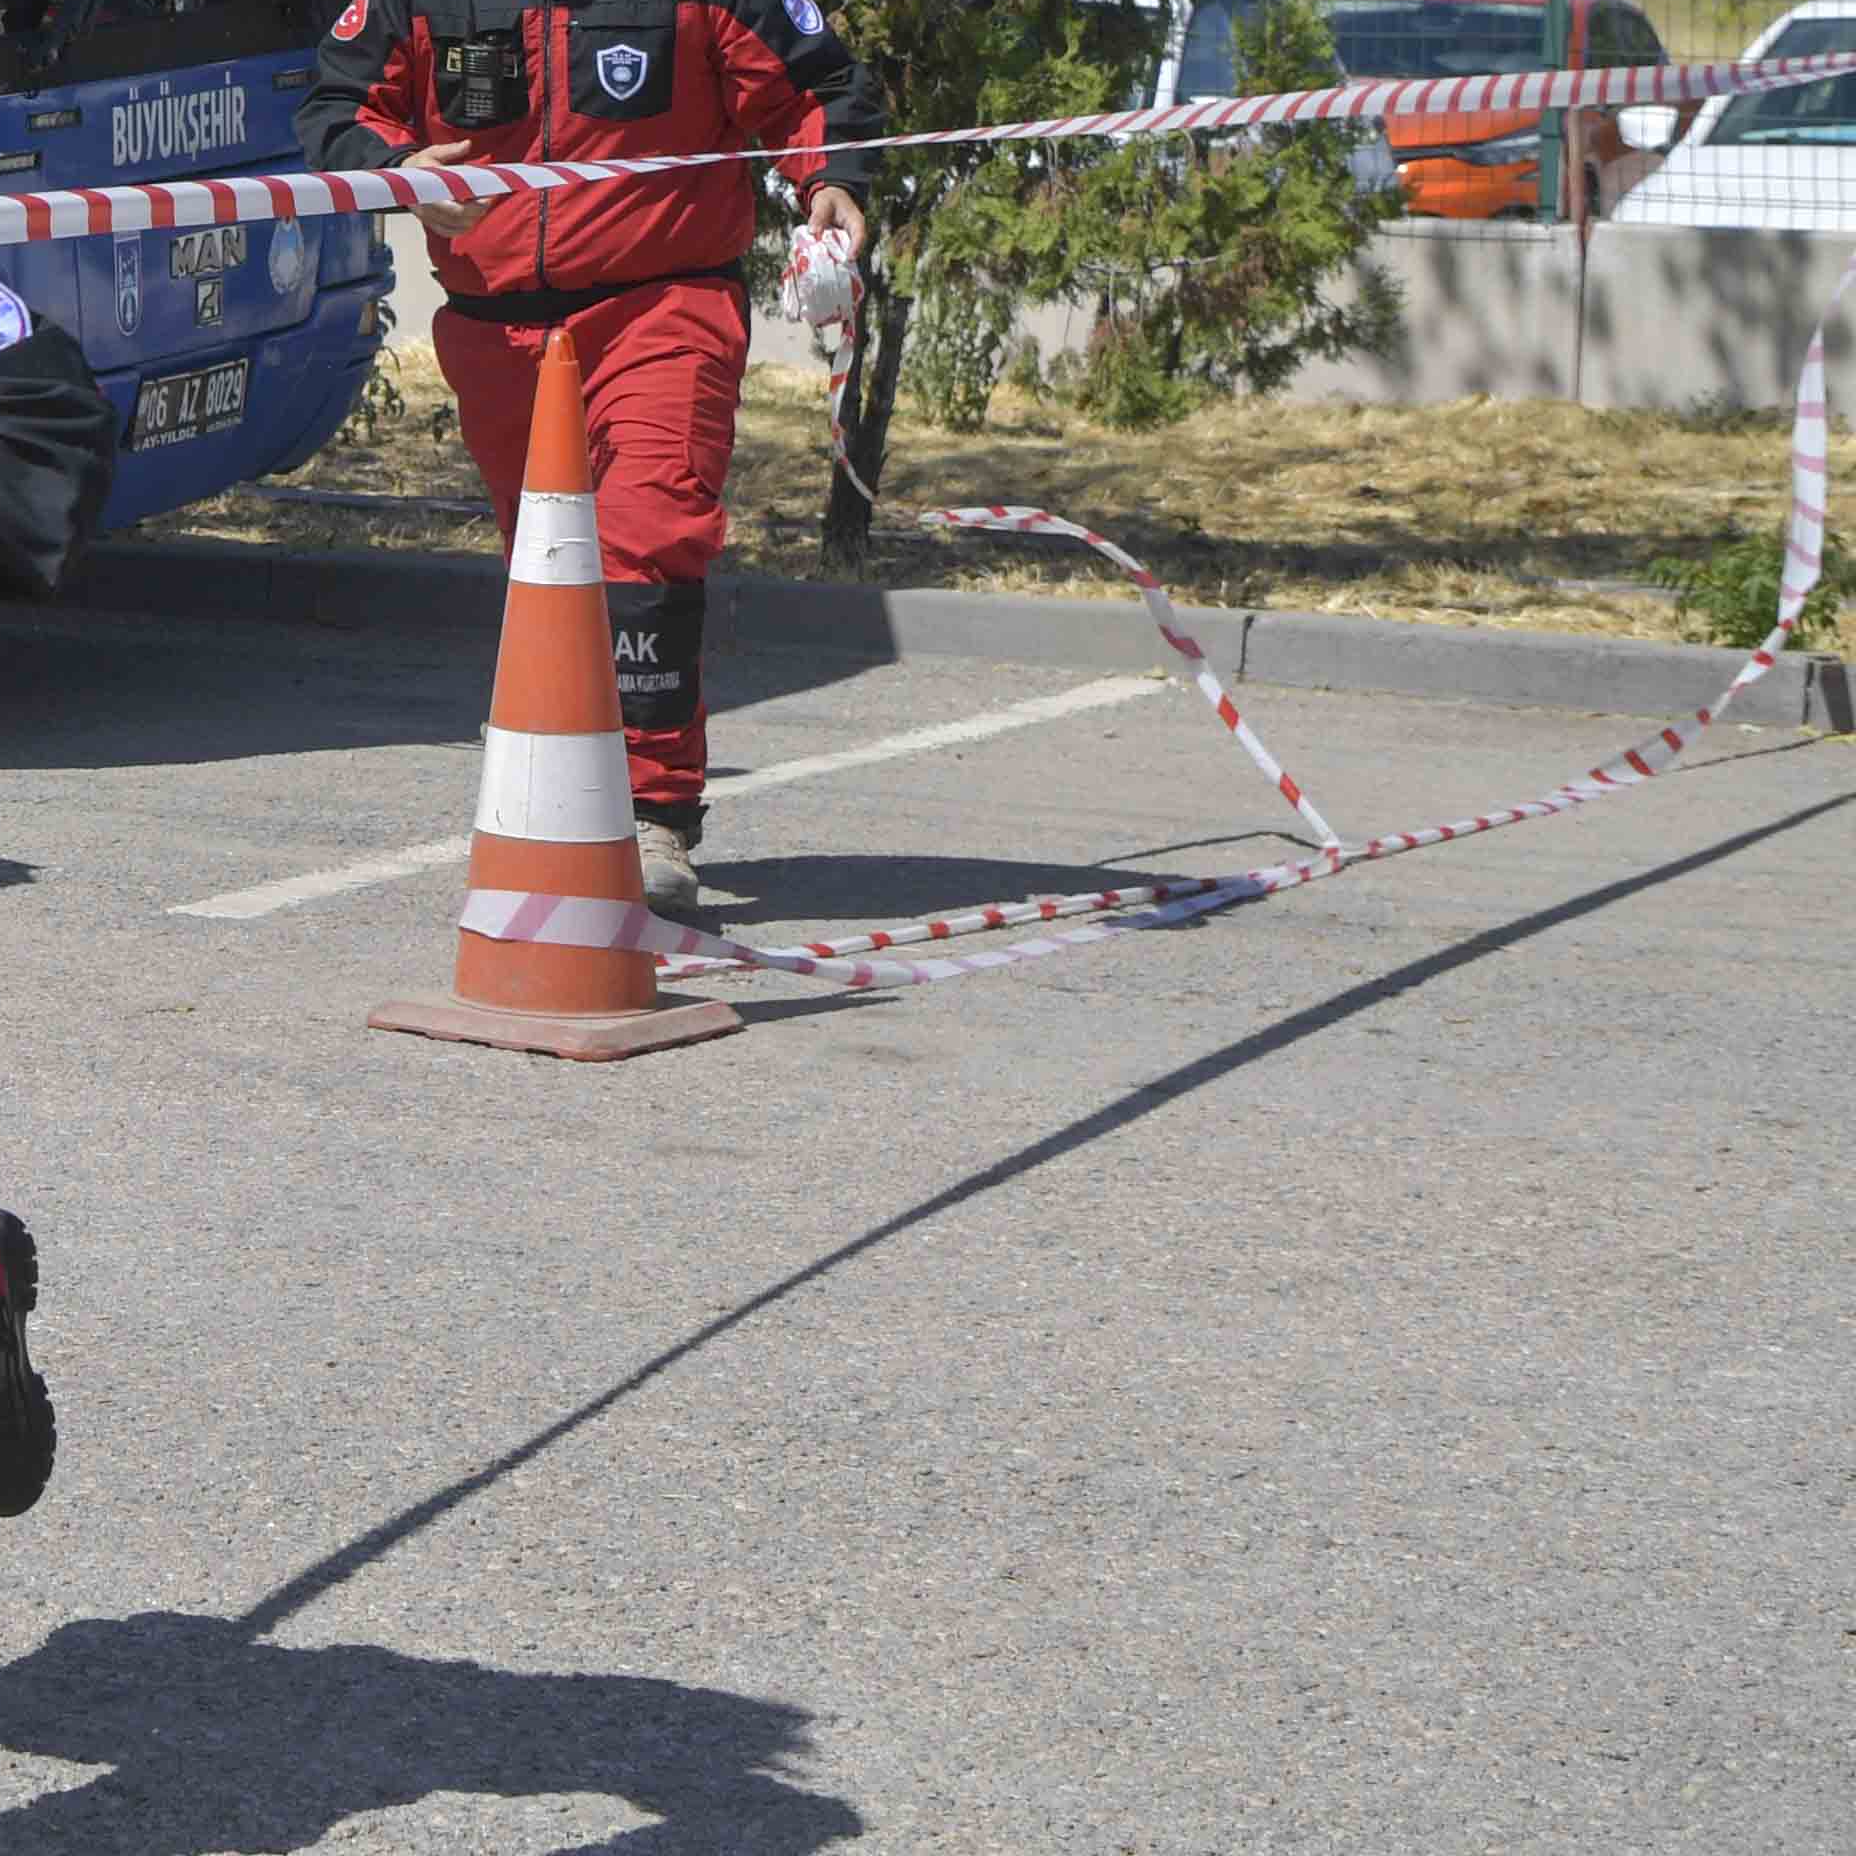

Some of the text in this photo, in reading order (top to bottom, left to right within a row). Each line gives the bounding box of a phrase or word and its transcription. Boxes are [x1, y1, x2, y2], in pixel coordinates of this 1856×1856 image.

[112, 71, 246, 166] BÜYÜKŞEHİR
[170, 225, 247, 279] MAN
[146, 368, 243, 430] 06 AZ 8029
[615, 631, 659, 662] AK
